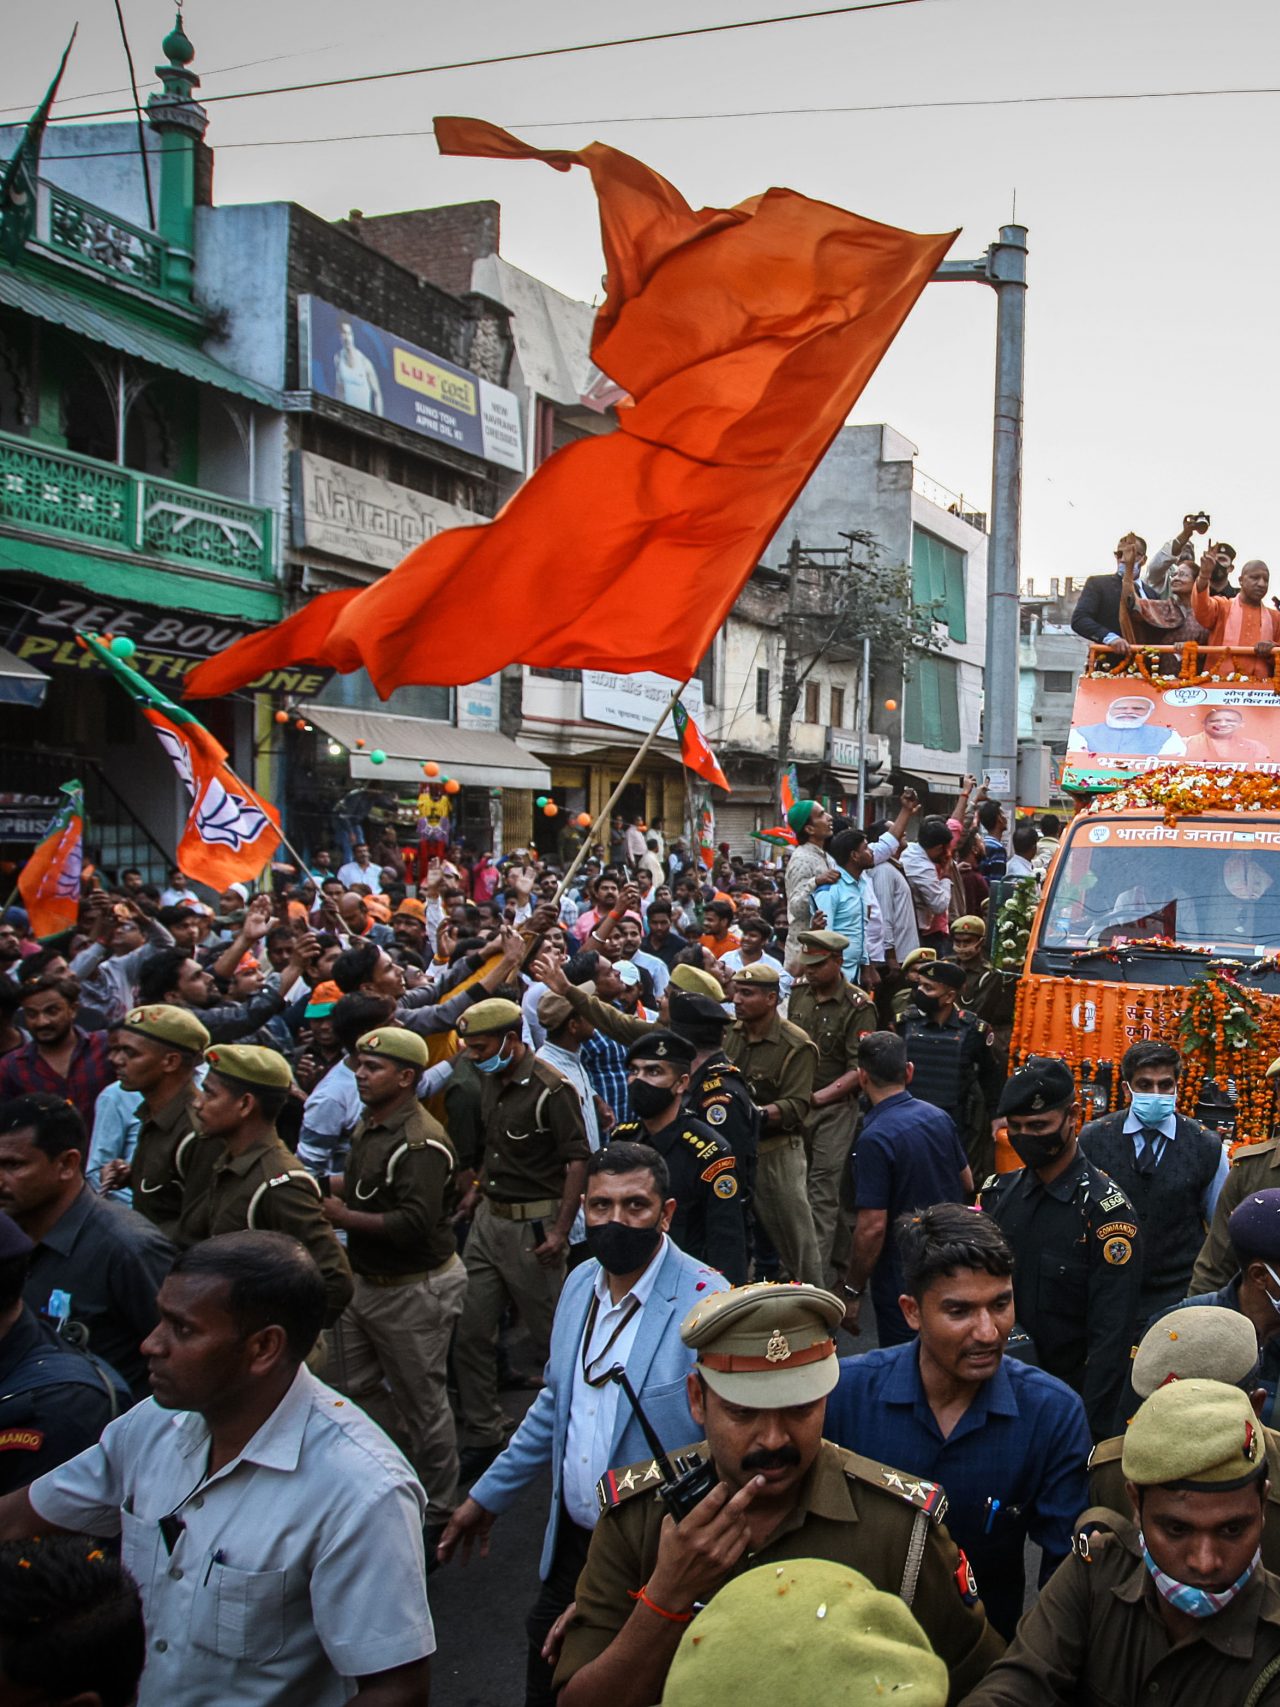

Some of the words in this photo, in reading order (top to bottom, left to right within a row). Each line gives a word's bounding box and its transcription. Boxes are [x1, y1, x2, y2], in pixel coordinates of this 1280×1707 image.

[401, 361, 436, 388] LUX
[37, 599, 143, 635] ZEE
[1116, 825, 1180, 841] भारतीय
[1183, 828, 1234, 842] जनता
[1102, 1194, 1123, 1210] NSG
[1098, 1223, 1135, 1237] COMMANDO
[0, 1432, 40, 1446] MANDO
